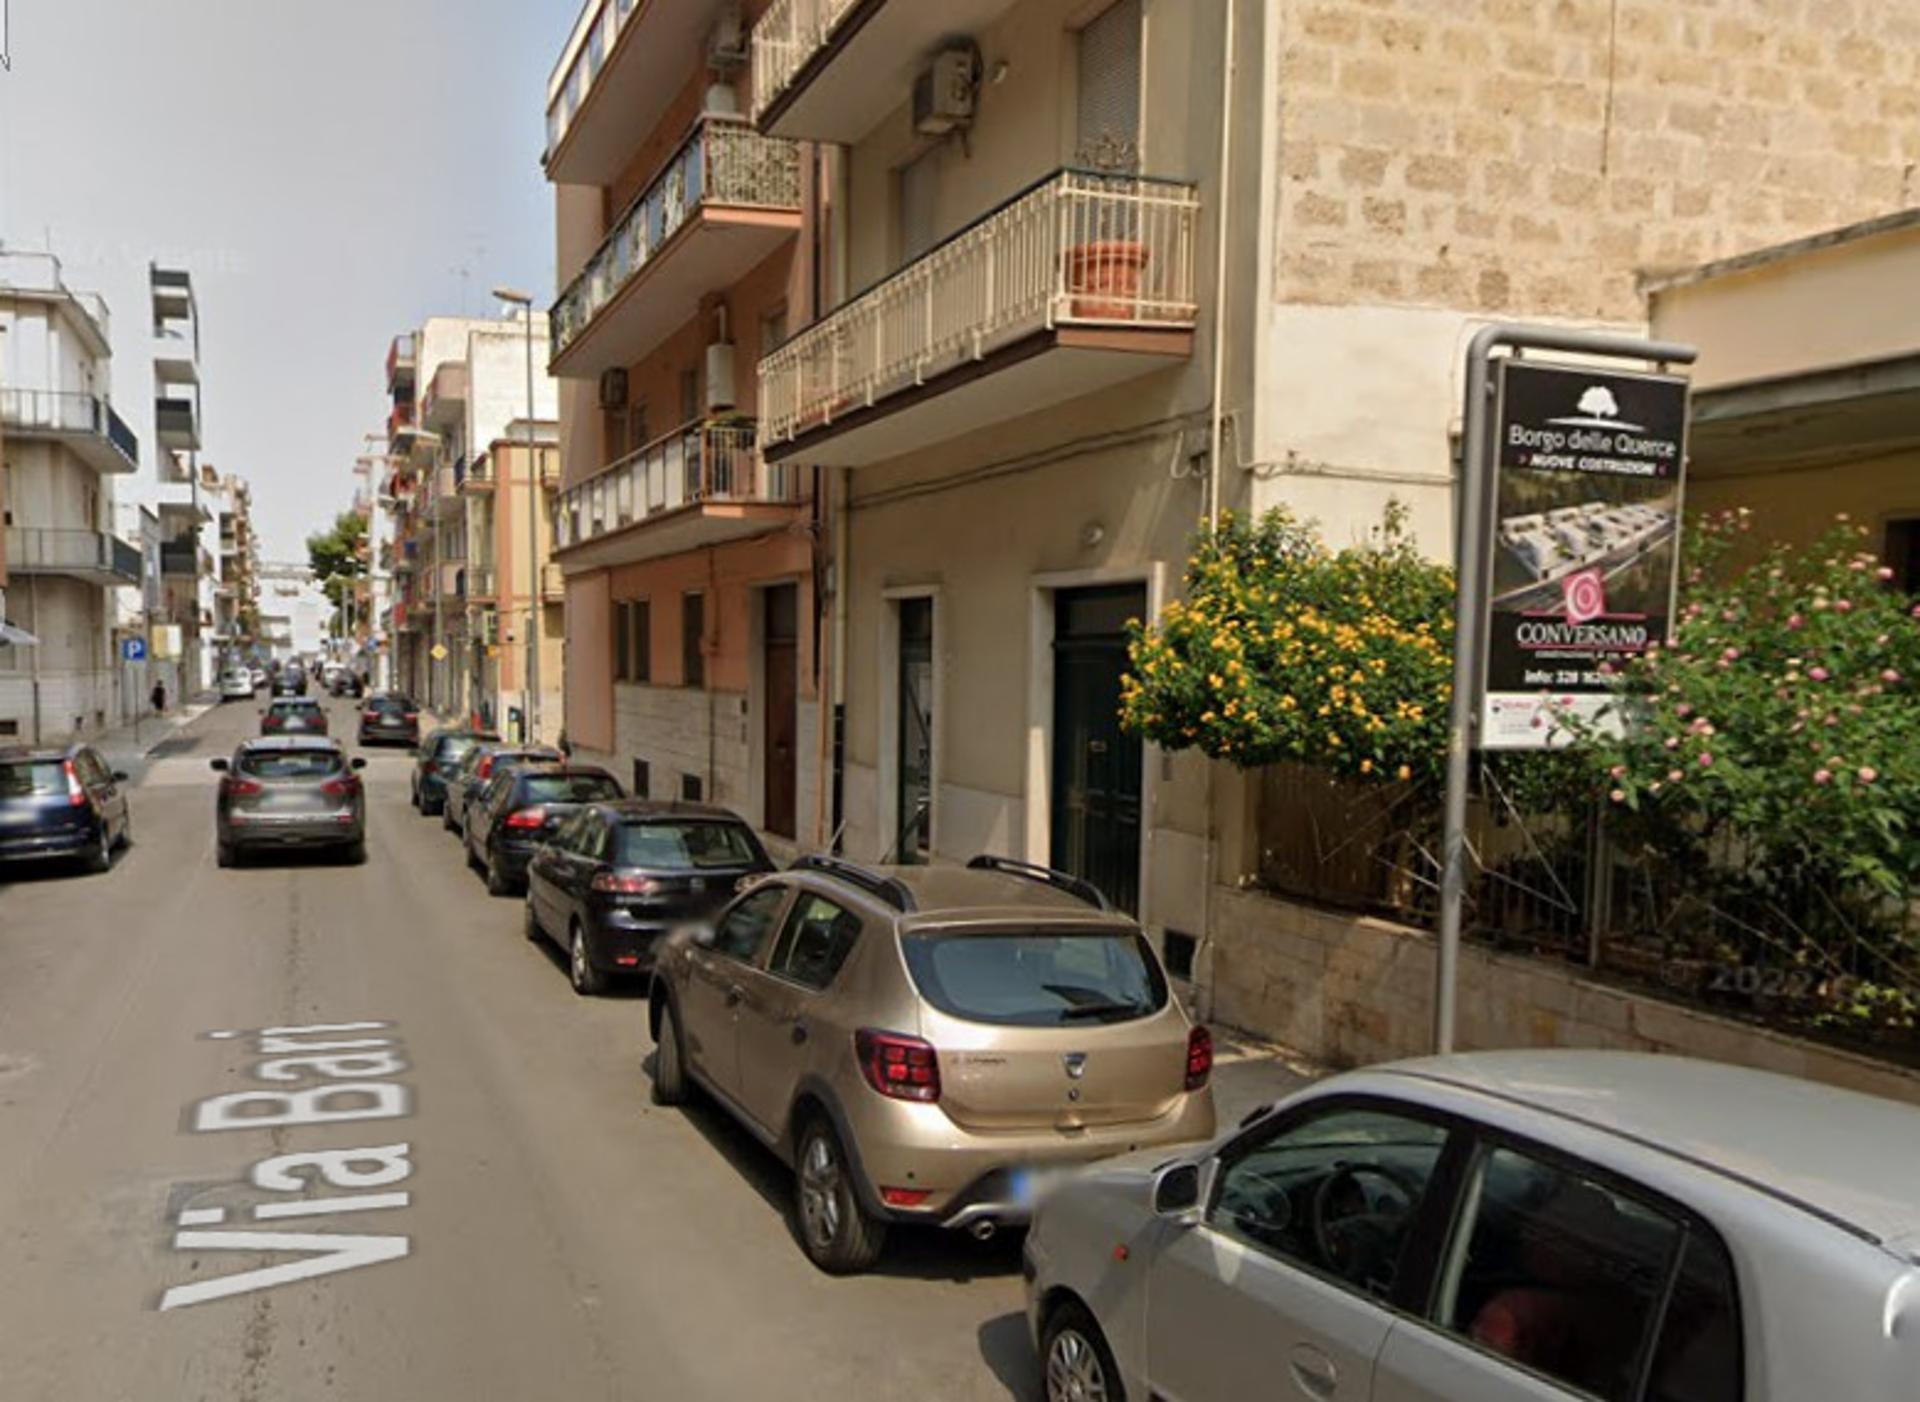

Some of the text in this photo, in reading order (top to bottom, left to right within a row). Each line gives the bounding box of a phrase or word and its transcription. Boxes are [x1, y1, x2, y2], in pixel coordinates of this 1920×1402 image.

[1508, 423, 1676, 458] Borgo delle Querce
[1516, 622, 1648, 648] CONVERSANO
[127, 639, 142, 658] P
